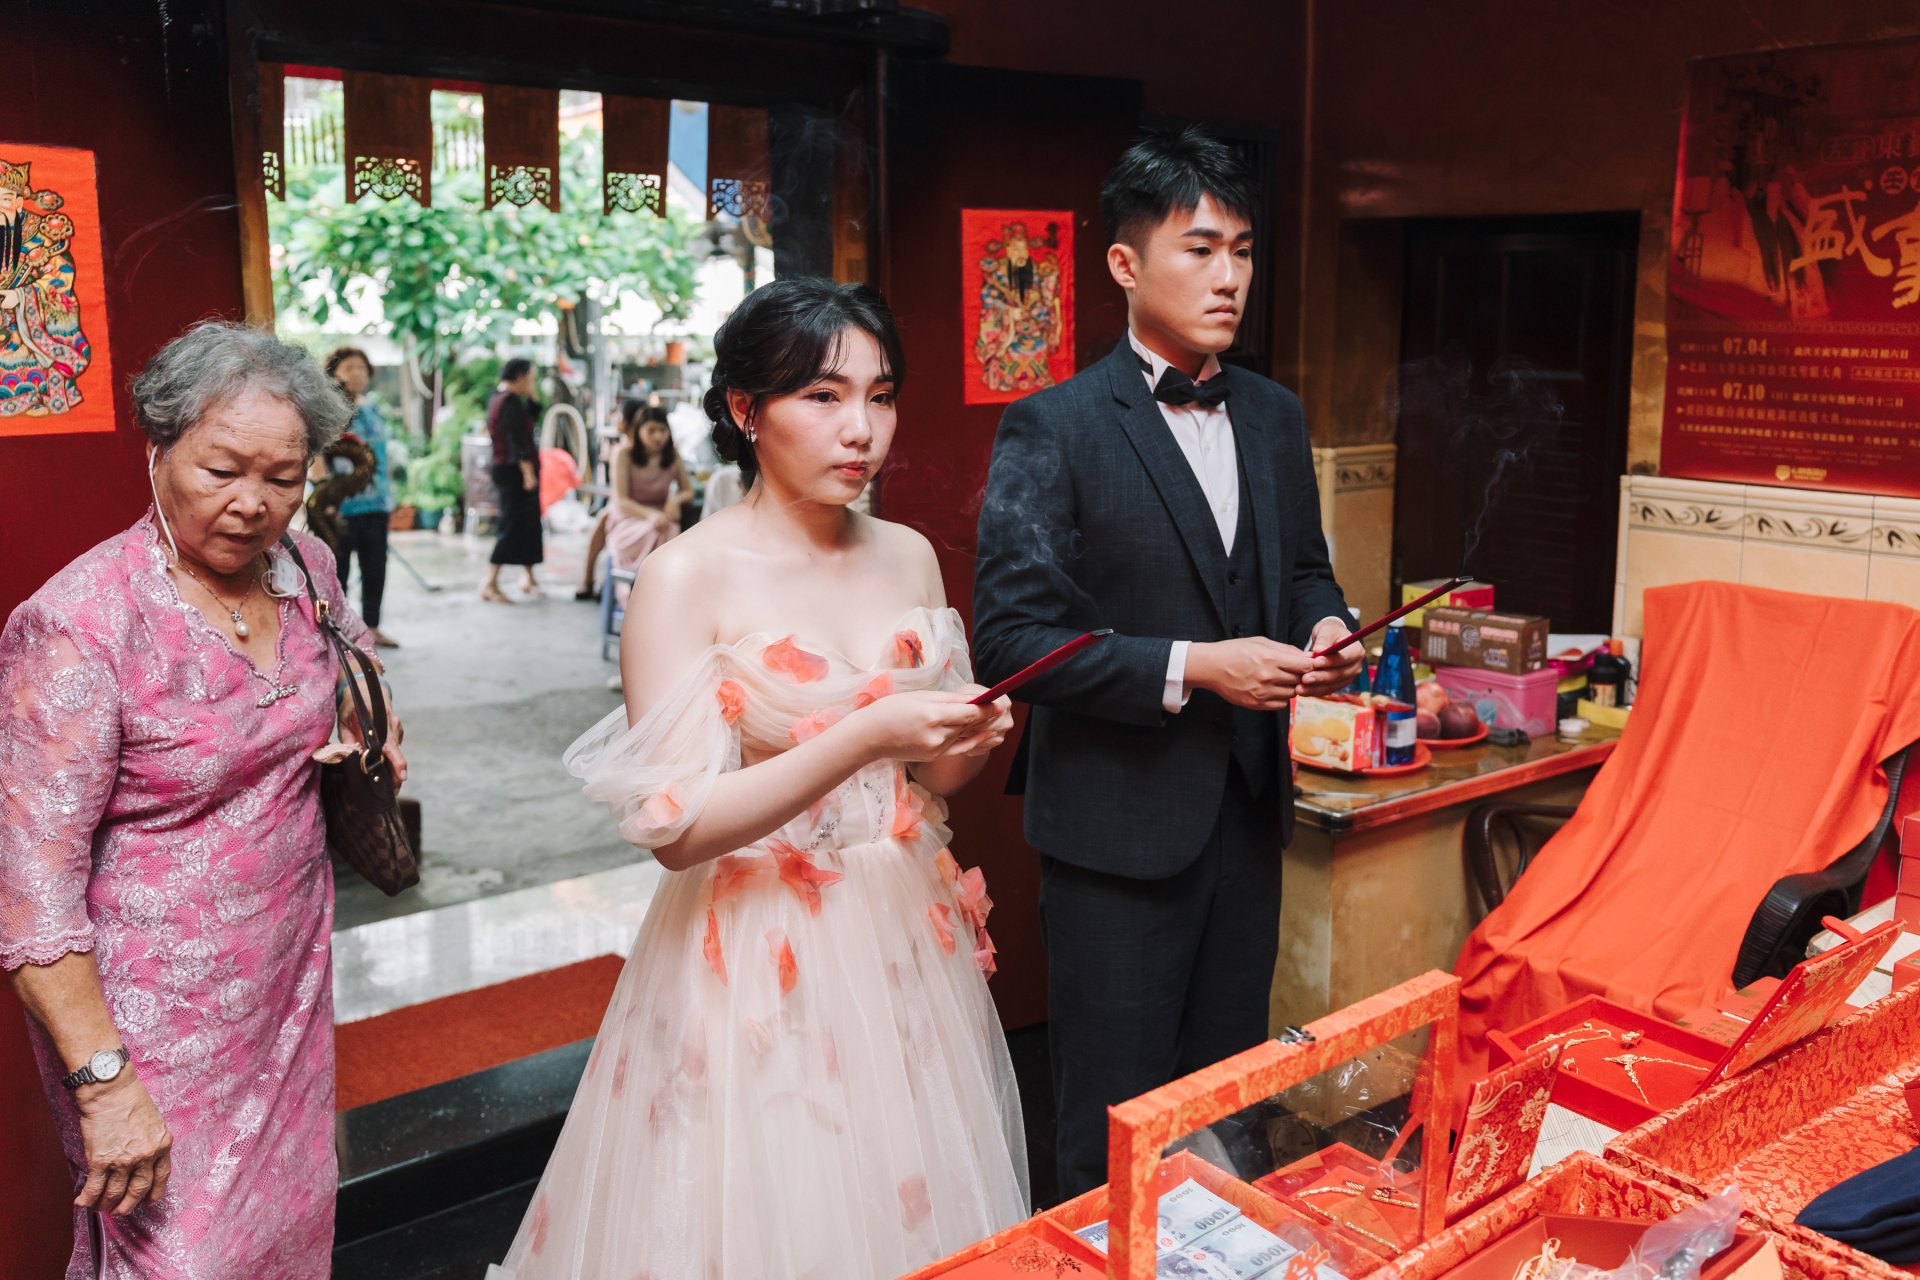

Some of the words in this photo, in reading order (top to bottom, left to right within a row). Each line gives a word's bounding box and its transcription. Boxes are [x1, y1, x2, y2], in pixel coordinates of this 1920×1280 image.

[1722, 337, 1768, 355] 07.04
[1722, 382, 1766, 400] 07.10
[1169, 1187, 1194, 1203] 1000
[1194, 1207, 1231, 1230] 1000
[1222, 1222, 1247, 1237] 1000
[1250, 1244, 1287, 1266] 1000
